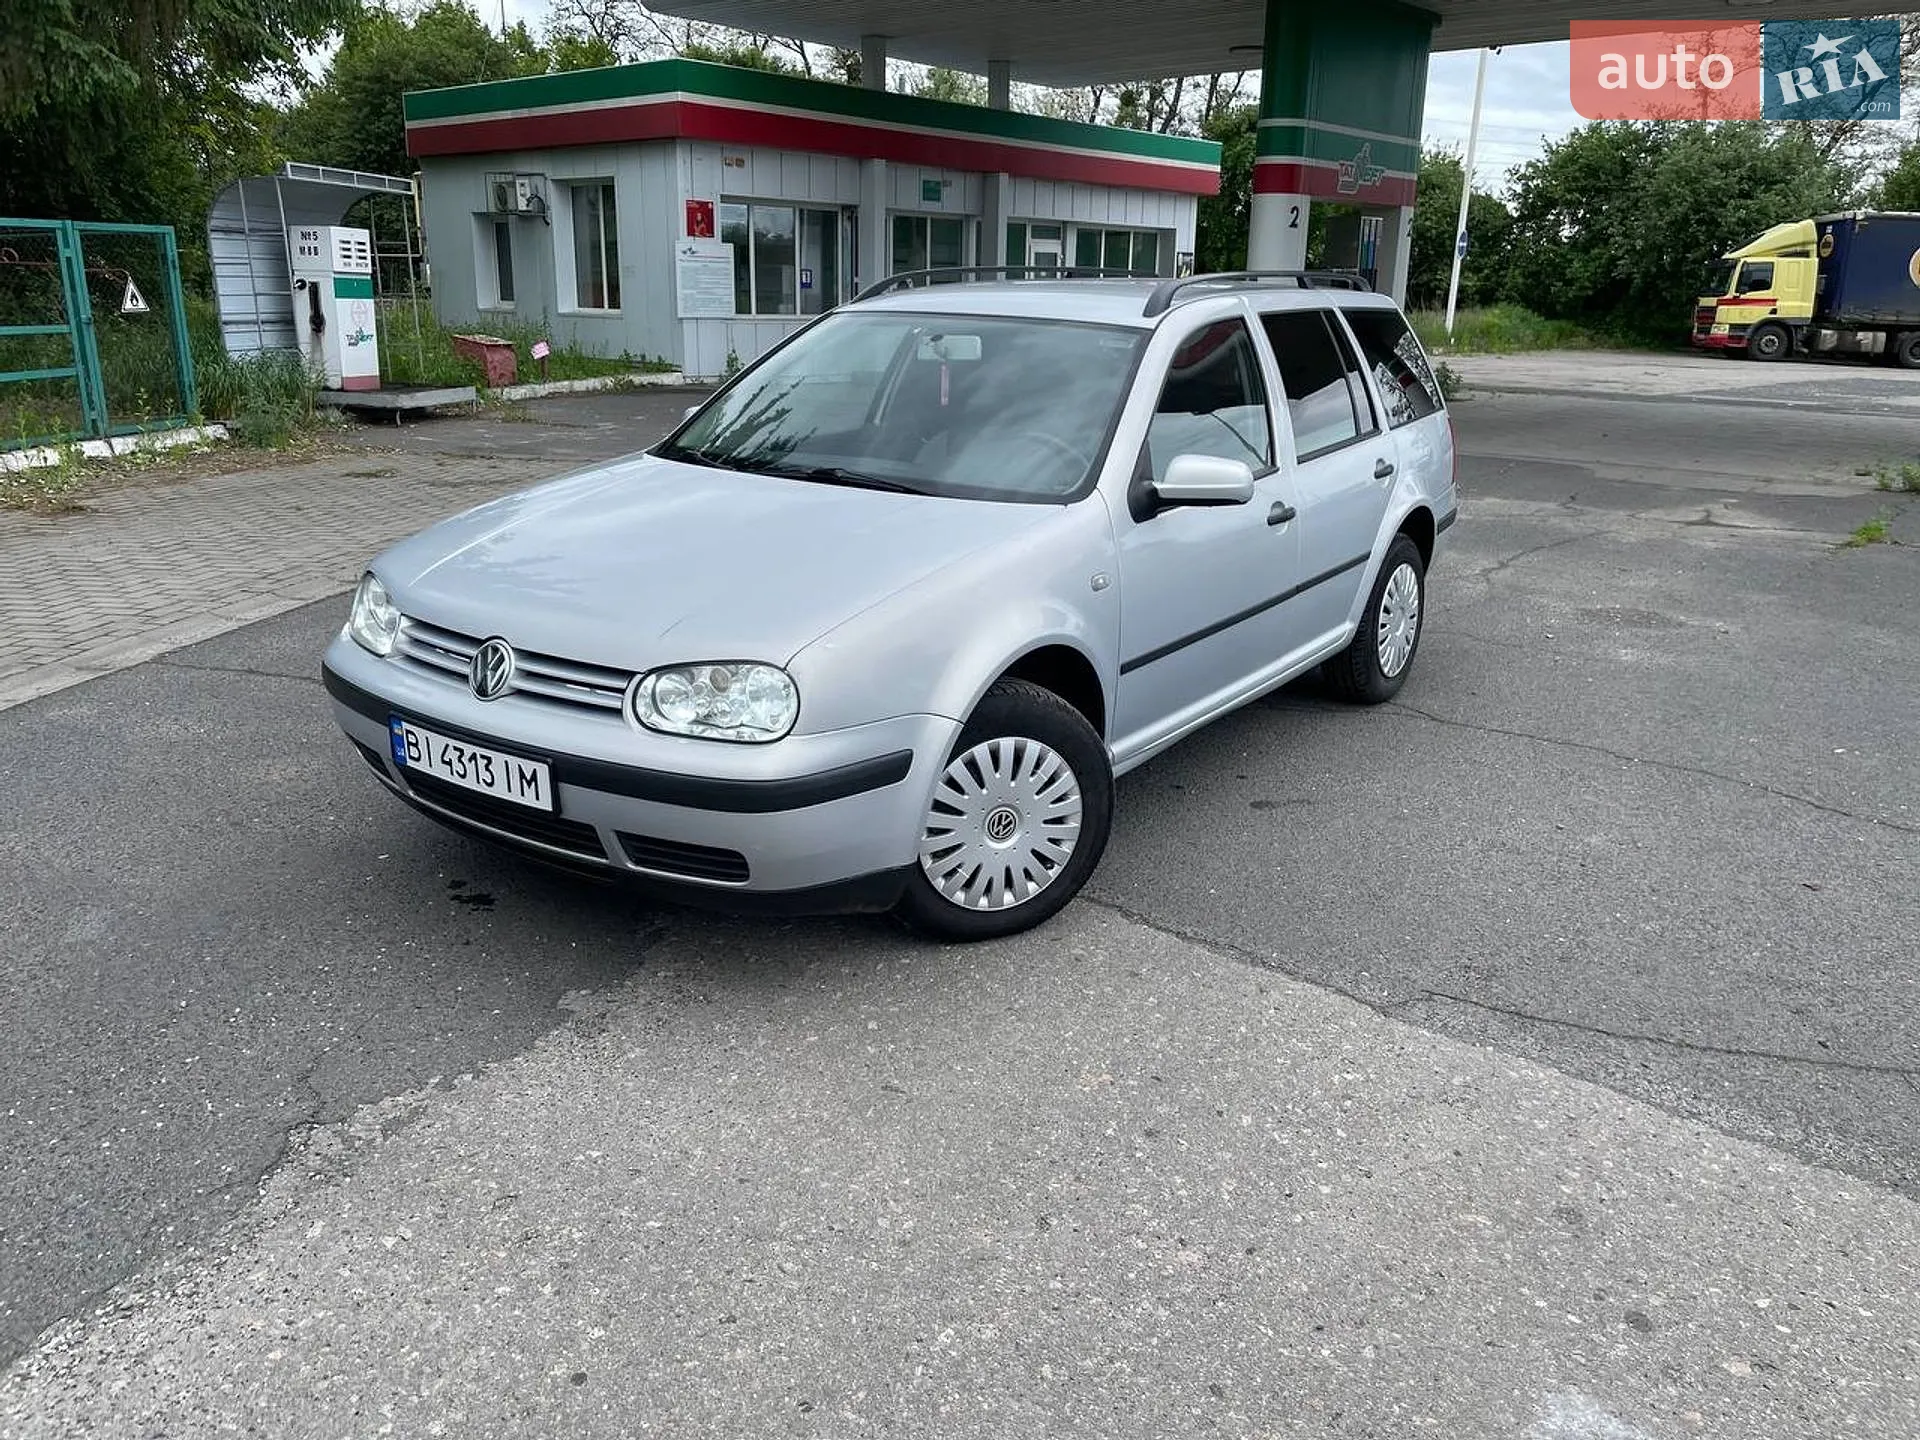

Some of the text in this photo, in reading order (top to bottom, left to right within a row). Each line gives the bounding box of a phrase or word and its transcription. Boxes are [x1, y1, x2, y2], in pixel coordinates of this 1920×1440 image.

[1288, 205, 1299, 229] 2
[405, 729, 540, 801] BI 4313 IM
